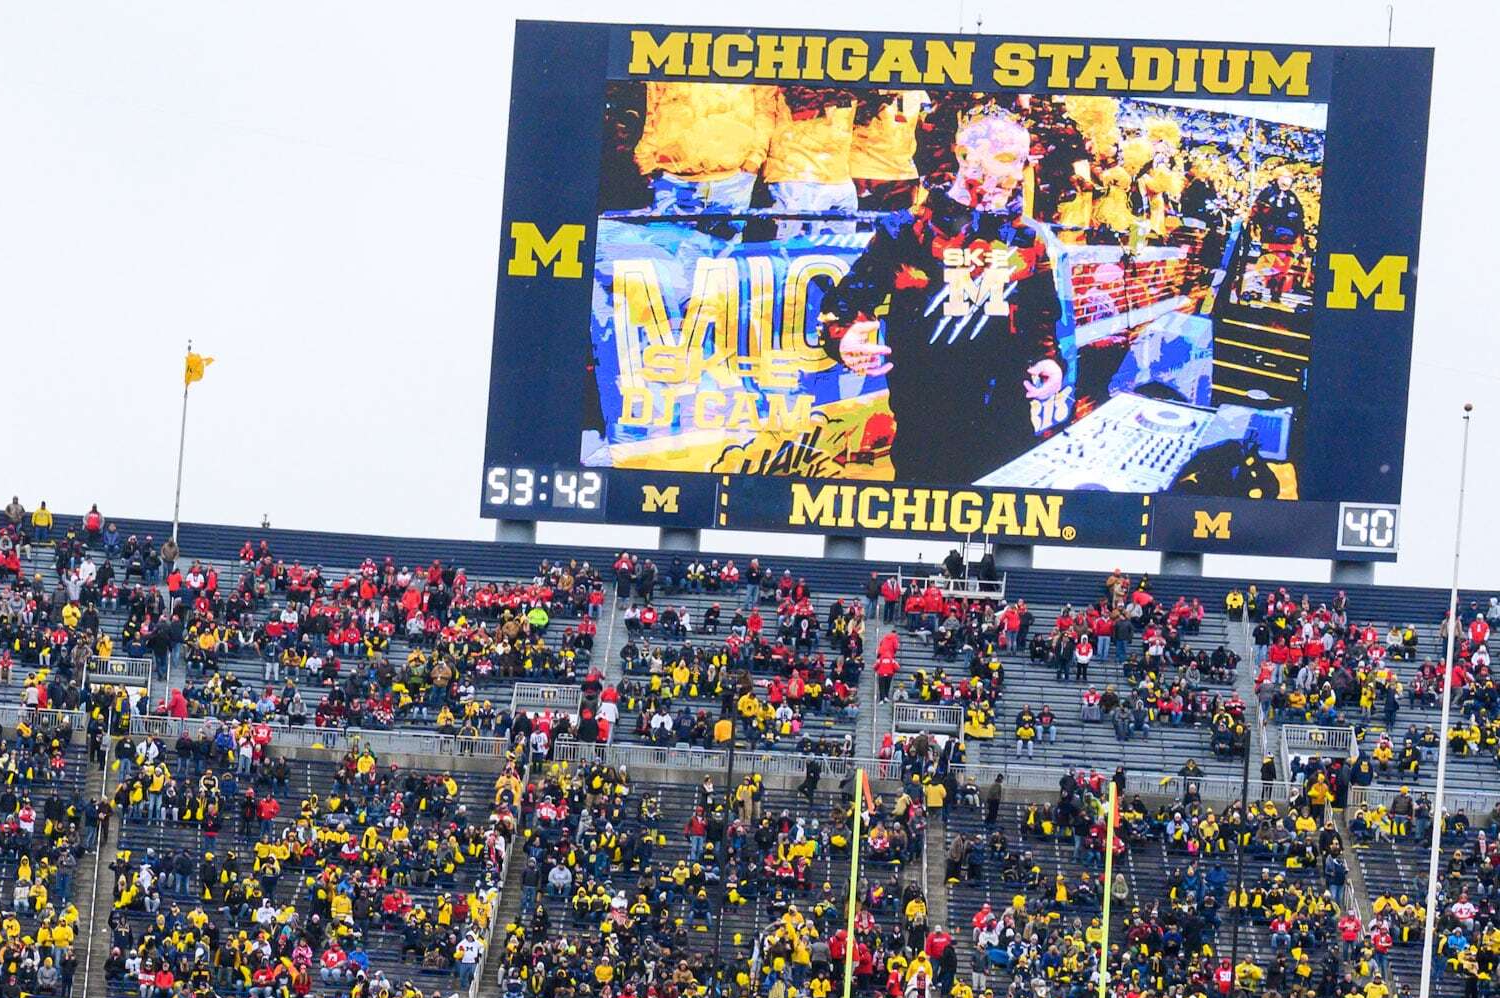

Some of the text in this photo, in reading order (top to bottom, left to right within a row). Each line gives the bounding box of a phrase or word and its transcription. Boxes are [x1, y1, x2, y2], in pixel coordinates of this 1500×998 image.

[629, 31, 1311, 96] MICHIGAN STADIUM
[508, 222, 586, 278] M
[1326, 253, 1408, 311] M
[619, 387, 816, 432] DJ CAM
[487, 467, 600, 509] 53:42
[641, 485, 680, 513] M
[1193, 510, 1233, 540] M
[1345, 509, 1394, 547] 40
